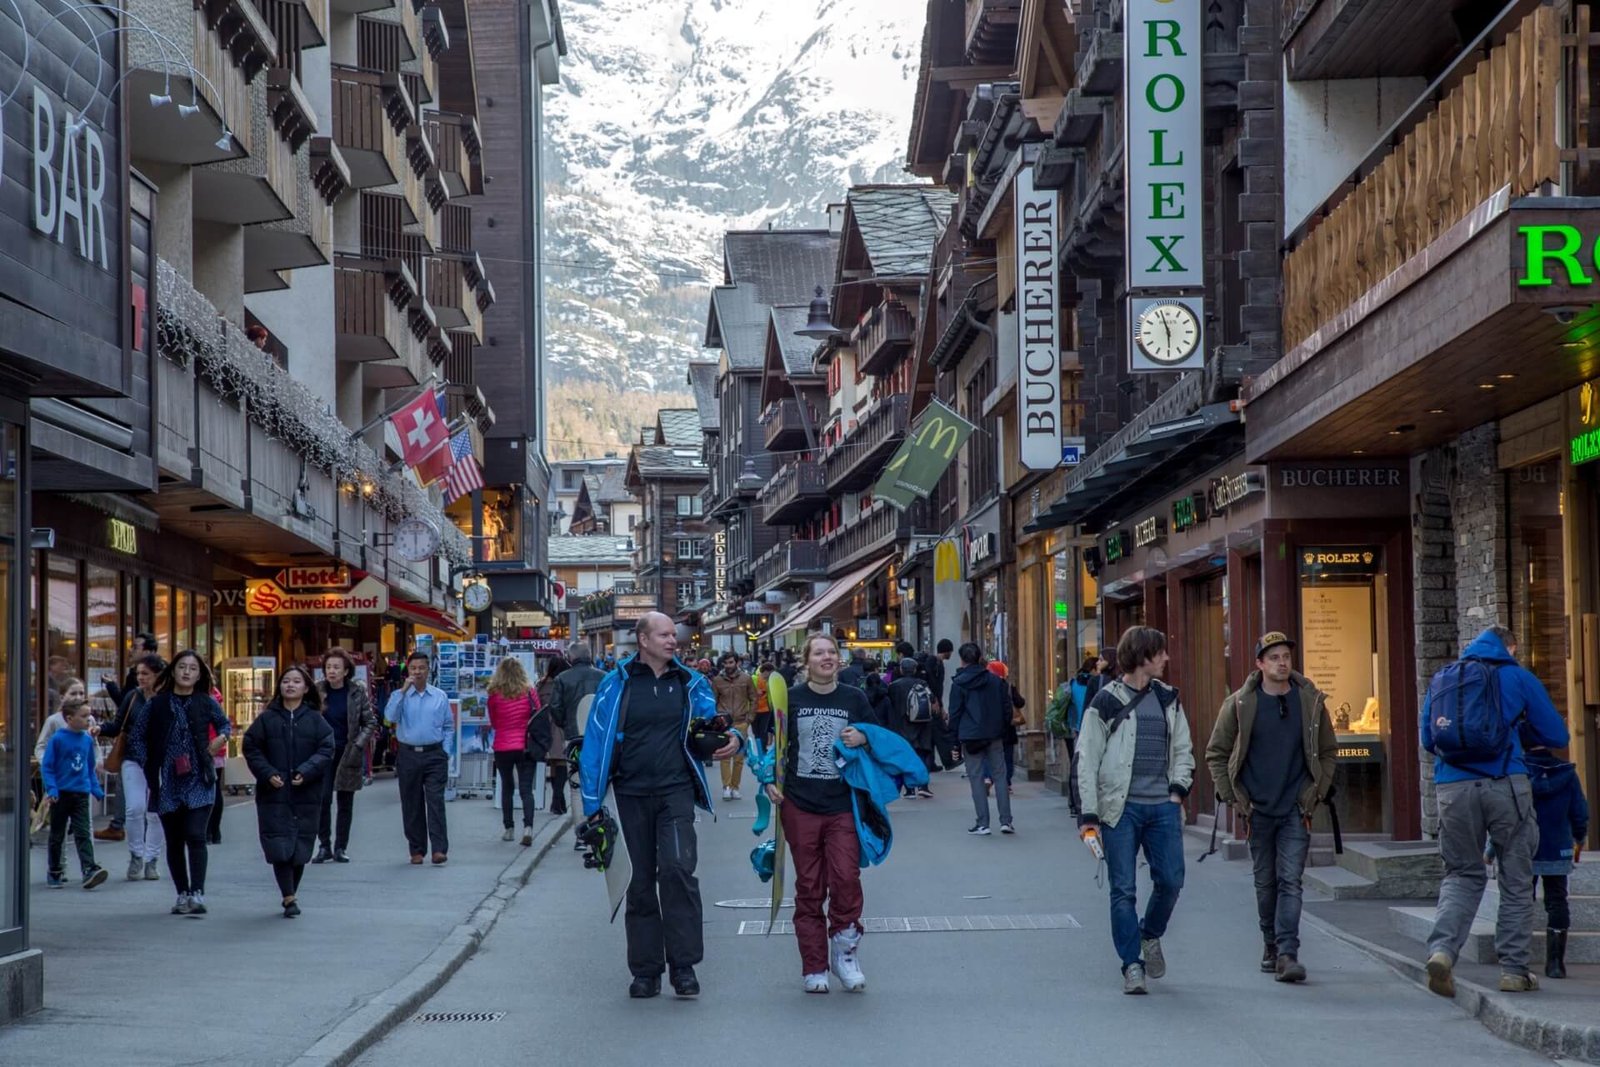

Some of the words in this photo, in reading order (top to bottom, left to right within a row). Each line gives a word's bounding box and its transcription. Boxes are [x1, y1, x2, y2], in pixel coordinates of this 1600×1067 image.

[1143, 19, 1188, 273] ROLEX
[33, 85, 108, 270] BAR
[1518, 225, 1600, 286] R
[1023, 198, 1056, 438] BUCHERER
[1281, 468, 1400, 488] BUCHERER
[715, 534, 727, 601] POLLUX
[1317, 553, 1360, 564] ROLEX
[291, 569, 347, 585] Hotel
[249, 582, 379, 613] Schweizerhof
[797, 707, 812, 717] JOY
[813, 707, 849, 718] DIVISION
[1336, 748, 1371, 758] HERER
